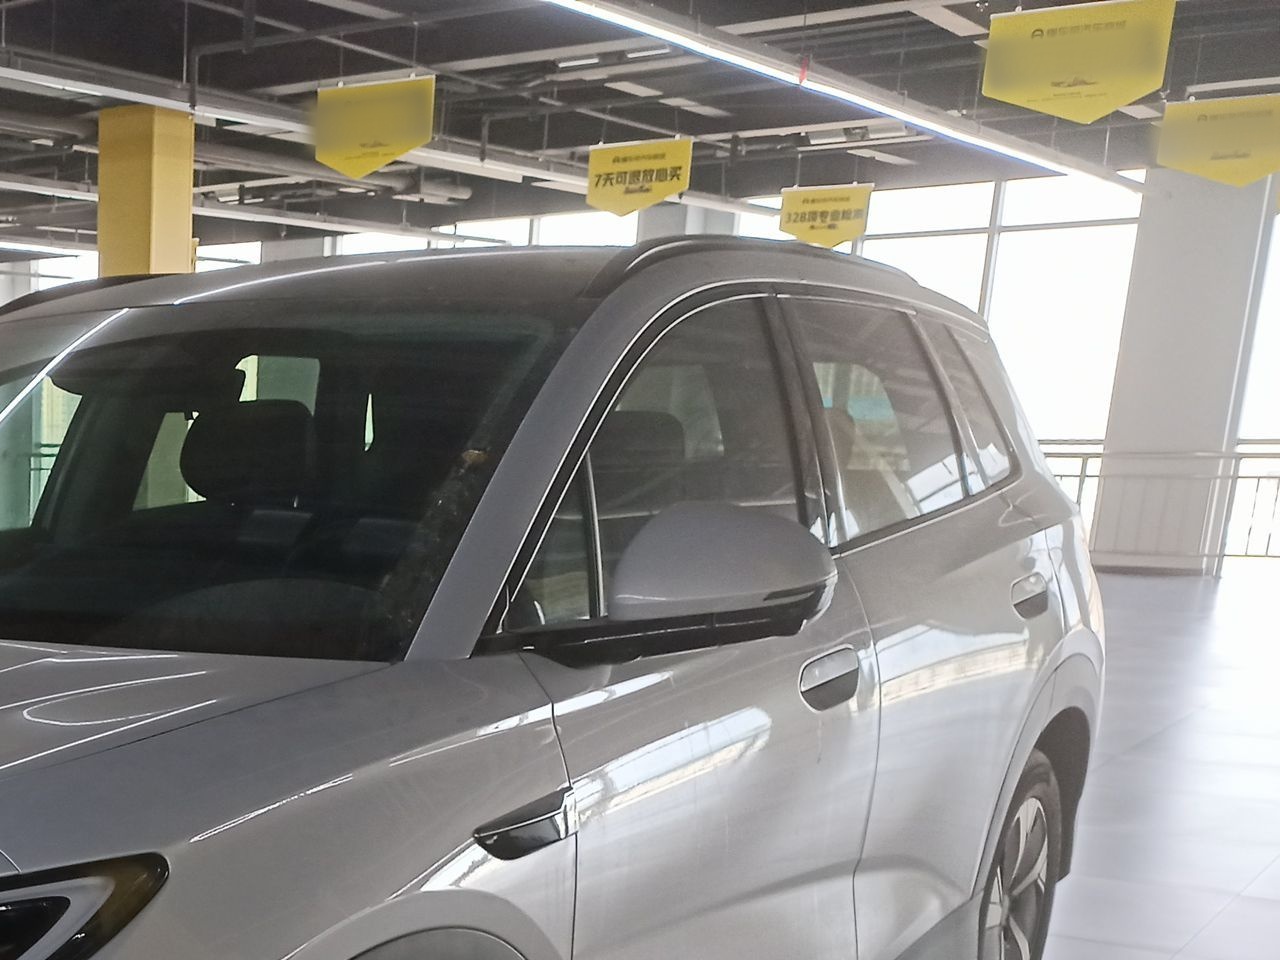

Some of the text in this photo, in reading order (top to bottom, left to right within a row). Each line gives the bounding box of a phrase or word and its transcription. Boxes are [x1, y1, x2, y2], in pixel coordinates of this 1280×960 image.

[594, 166, 682, 187] 7天可退放心买
